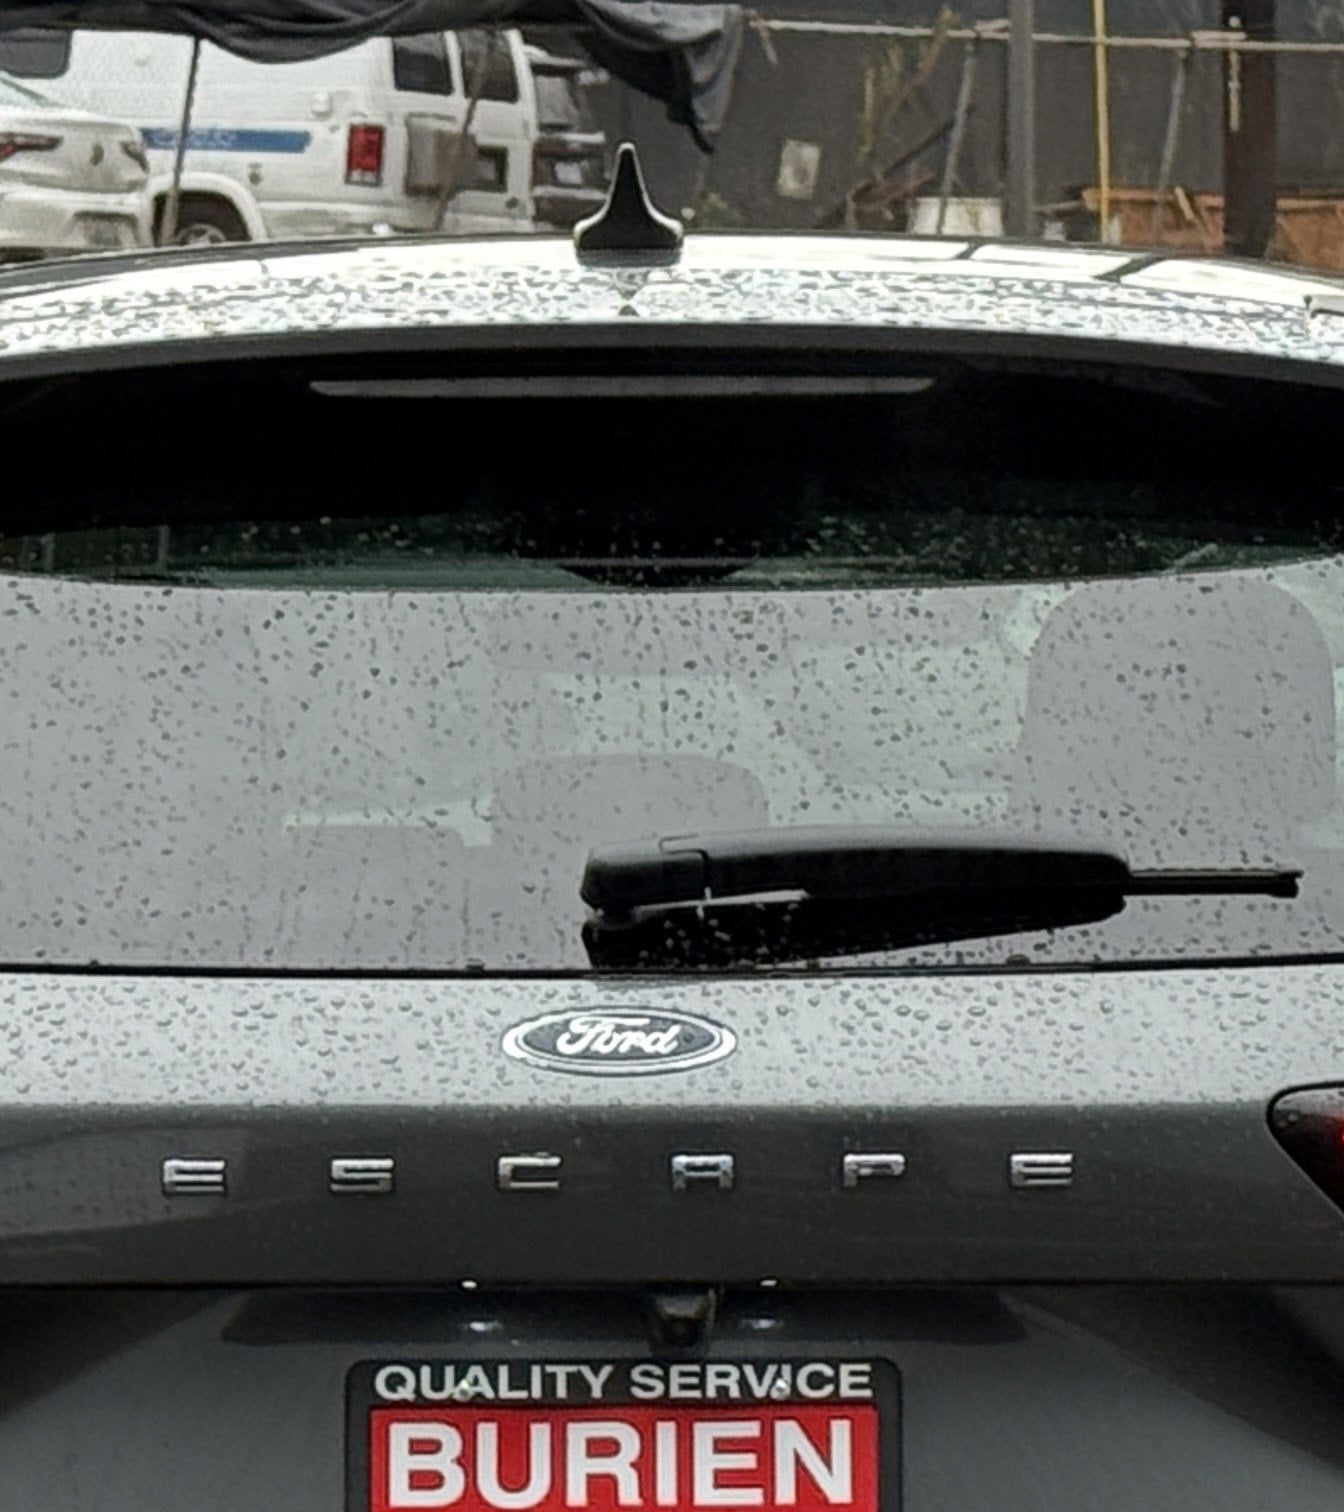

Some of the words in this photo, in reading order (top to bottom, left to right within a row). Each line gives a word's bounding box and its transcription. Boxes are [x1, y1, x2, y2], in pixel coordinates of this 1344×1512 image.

[556, 1016, 682, 1055] Ford
[163, 1153, 1075, 1192] ESCAPE
[375, 1364, 611, 1402] QUALITY
[630, 1363, 873, 1400] SERVICE
[388, 1420, 854, 1508] BURIEN
